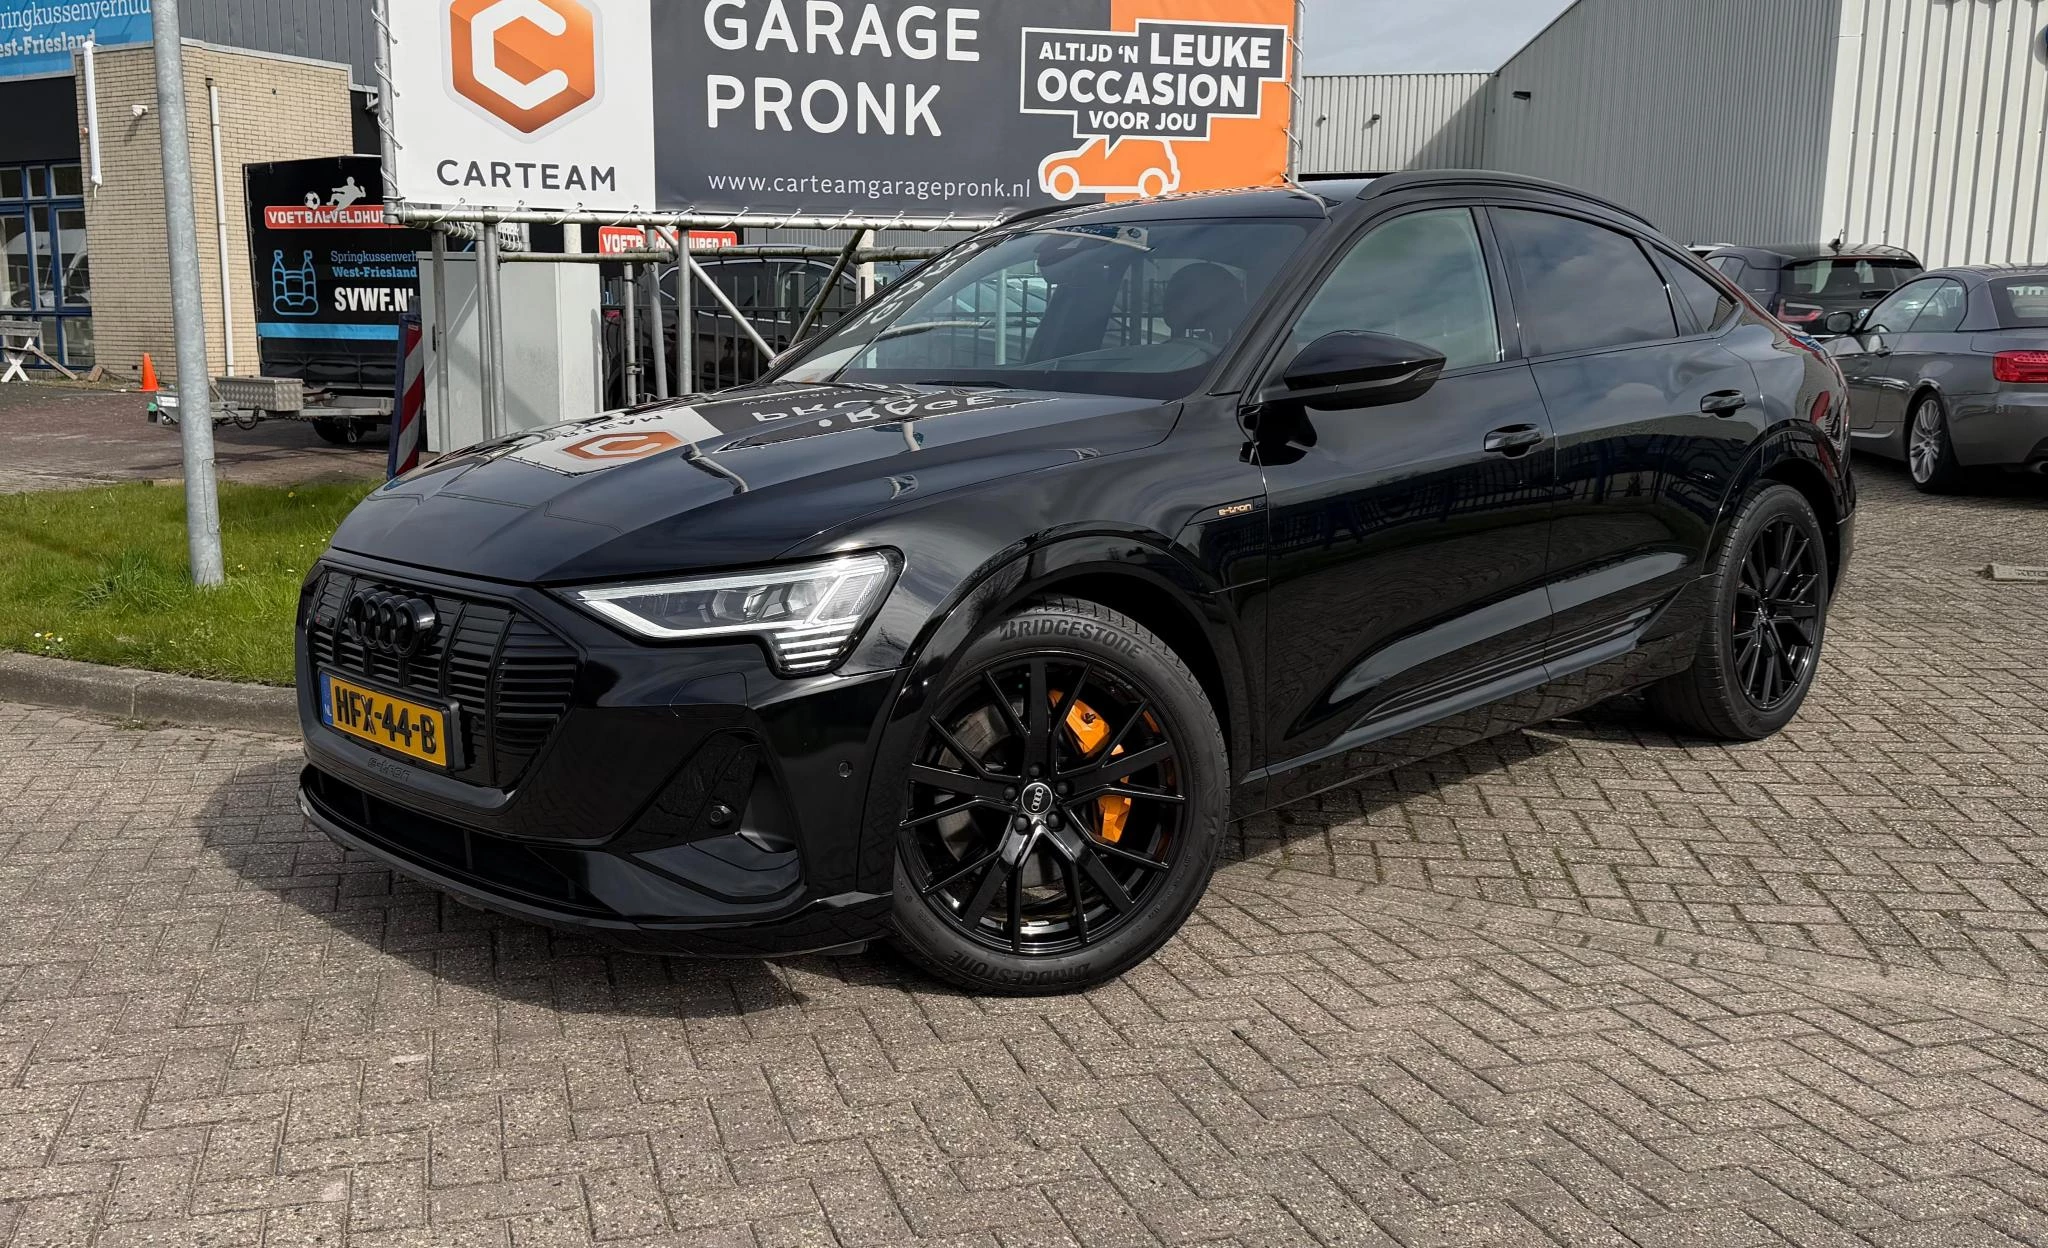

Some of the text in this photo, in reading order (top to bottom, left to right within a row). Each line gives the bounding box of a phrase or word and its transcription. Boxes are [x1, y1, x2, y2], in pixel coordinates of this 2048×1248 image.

[703, 0, 980, 61] GARAGE
[1039, 41, 1113, 63] ALTIJD
[1150, 32, 1271, 69] LEUKE
[706, 74, 943, 137] PRONK
[1037, 67, 1246, 108] OCCASION
[1088, 110, 1197, 131] VOOR JOU
[436, 159, 617, 192] CARTEAM
[708, 175, 1031, 200] www.carteamgaragepronk.nl
[332, 266, 418, 278] West-Friesland
[1218, 503, 1252, 516] e-tron
[999, 619, 1144, 659] BRIDGESTONE
[335, 685, 437, 754] HFX-44-B
